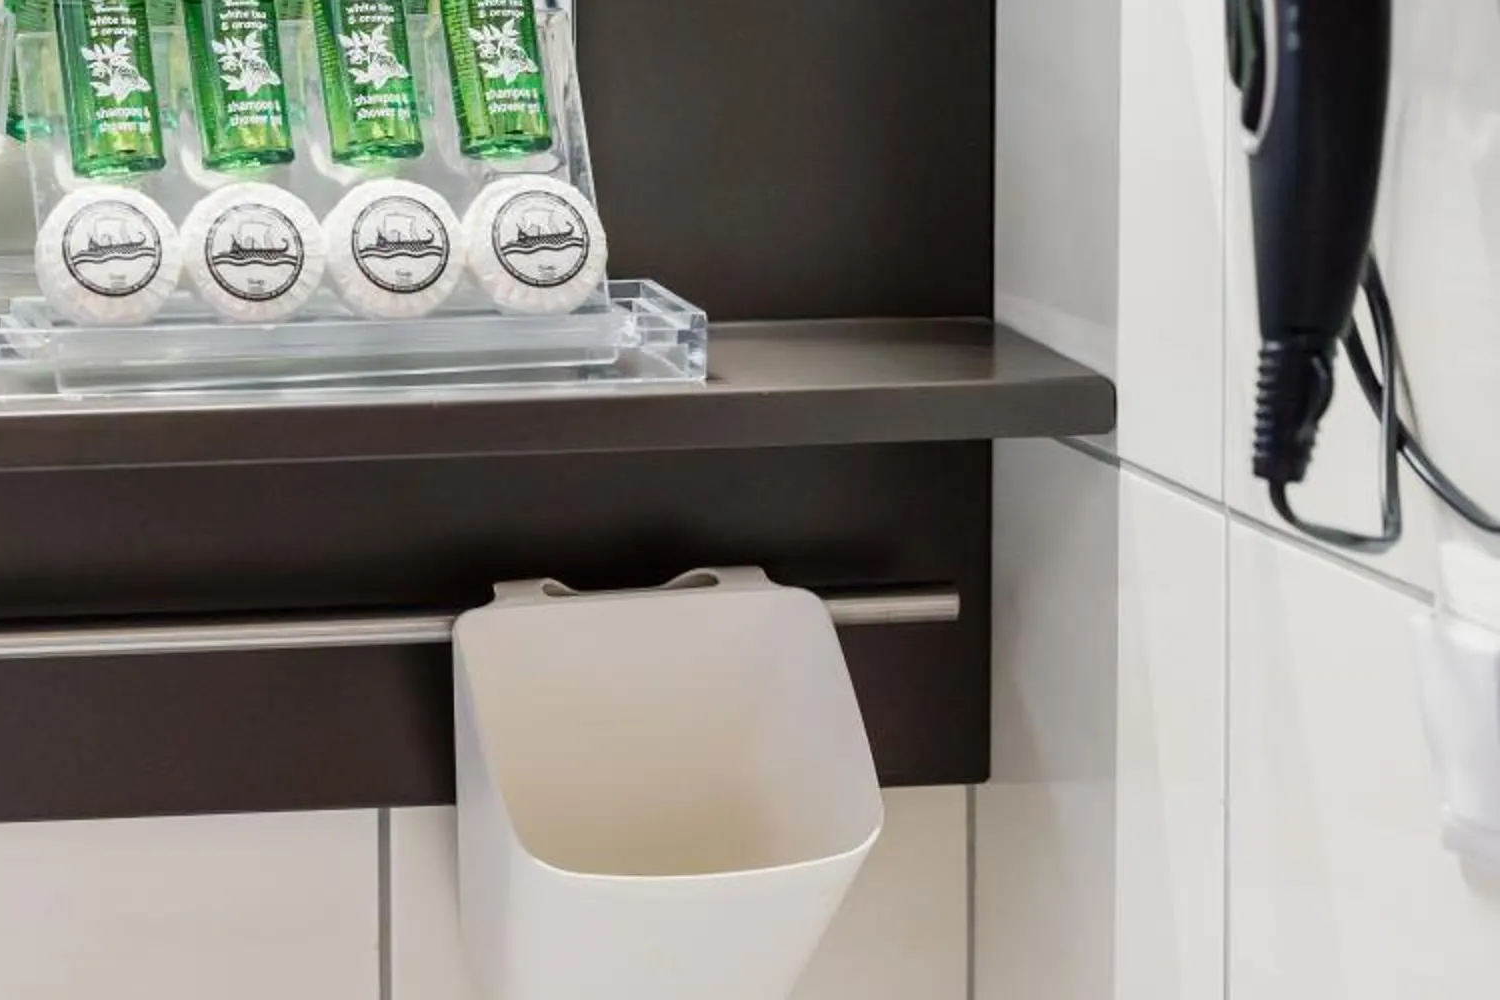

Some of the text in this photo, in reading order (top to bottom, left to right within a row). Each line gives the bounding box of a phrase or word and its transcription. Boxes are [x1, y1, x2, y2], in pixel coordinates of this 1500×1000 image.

[345, 3, 376, 14] white
[219, 9, 249, 20] white
[89, 15, 119, 27] white
